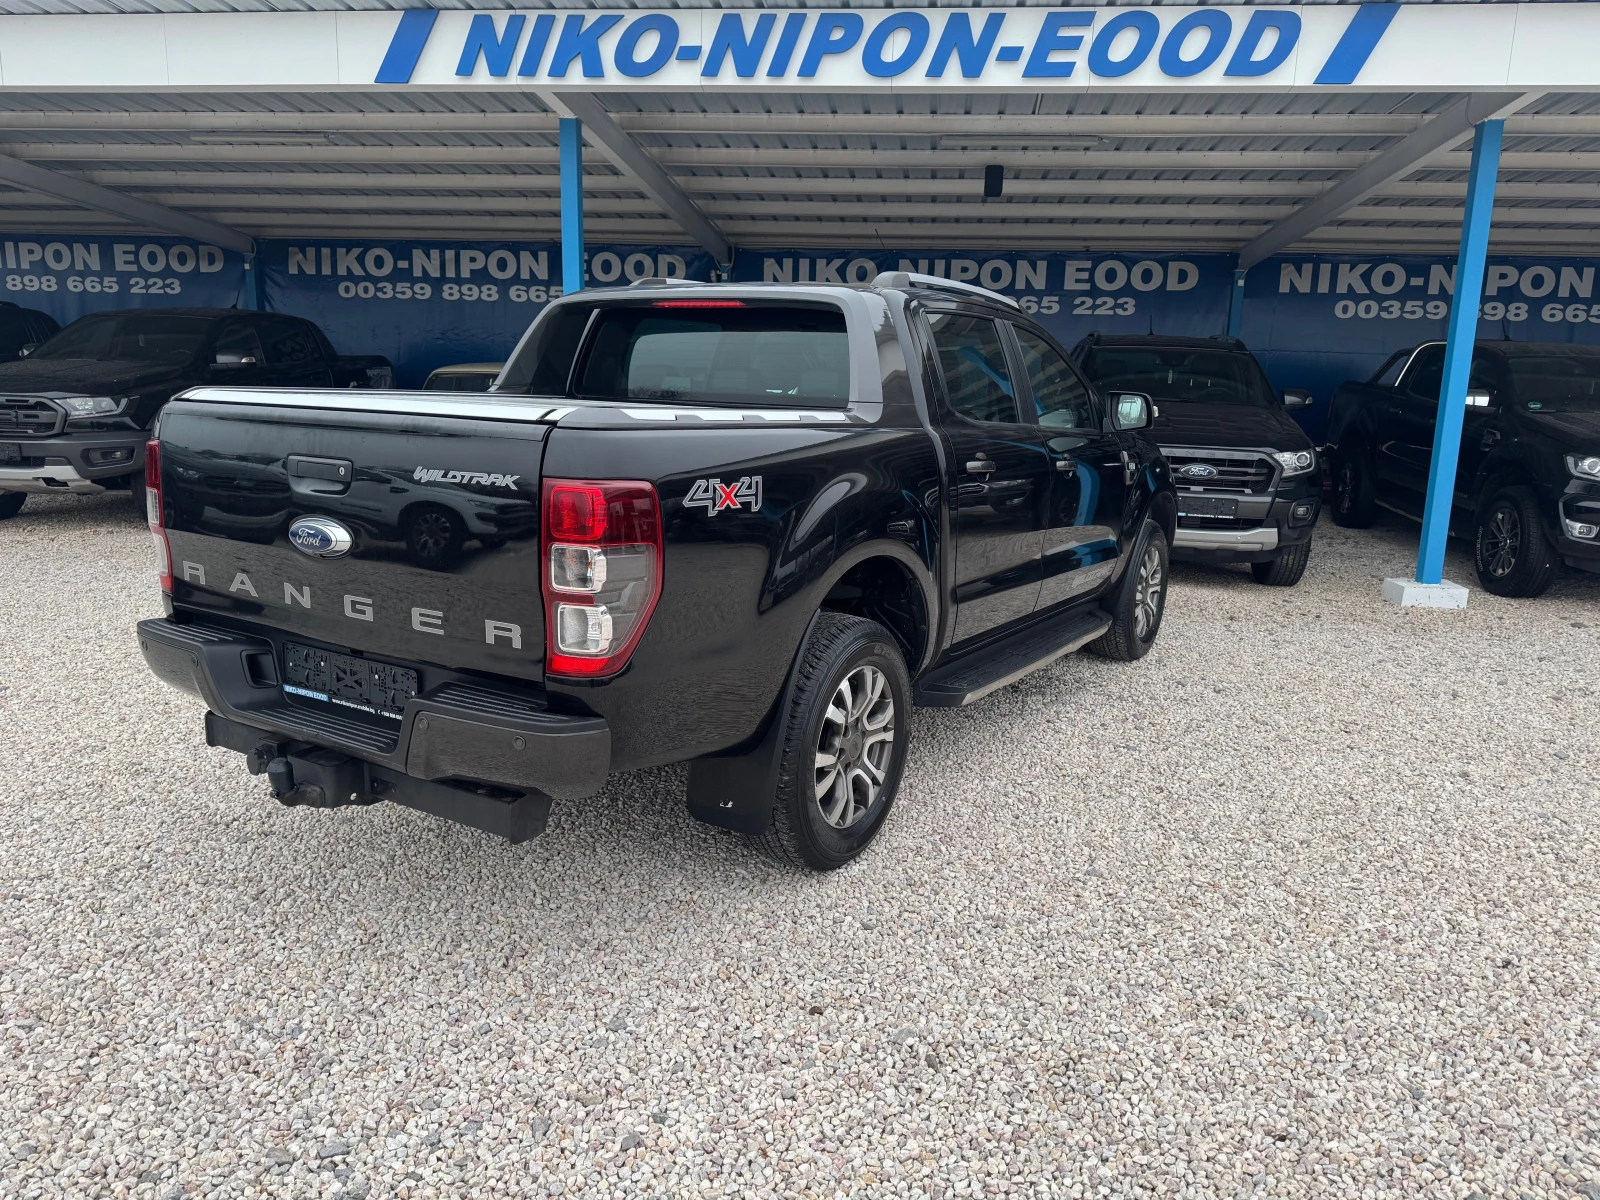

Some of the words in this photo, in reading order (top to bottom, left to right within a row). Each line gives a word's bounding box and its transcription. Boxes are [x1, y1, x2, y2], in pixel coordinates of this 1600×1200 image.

[455, 8, 1302, 78] NIKO-NIPON-EOOD
[0, 241, 100, 271] IPON
[113, 243, 225, 274] EOOD
[288, 247, 549, 280] NIKO-NIPON
[6, 275, 58, 292] 898
[66, 277, 119, 293] 665
[129, 278, 182, 295] 223
[1064, 260, 1199, 291] EOOD
[1278, 263, 1596, 298] NIKO-NPON
[338, 281, 432, 300] 00359
[442, 284, 499, 302] 898
[1004, 295, 1060, 315] 65
[1072, 297, 1136, 316] 223
[1334, 300, 1448, 320] 00359
[1477, 301, 1529, 322] 98
[413, 466, 520, 490] WILDTRAK
[1188, 466, 1210, 476] Ford
[296, 527, 322, 547] Ford
[182, 560, 523, 650] RANGER
